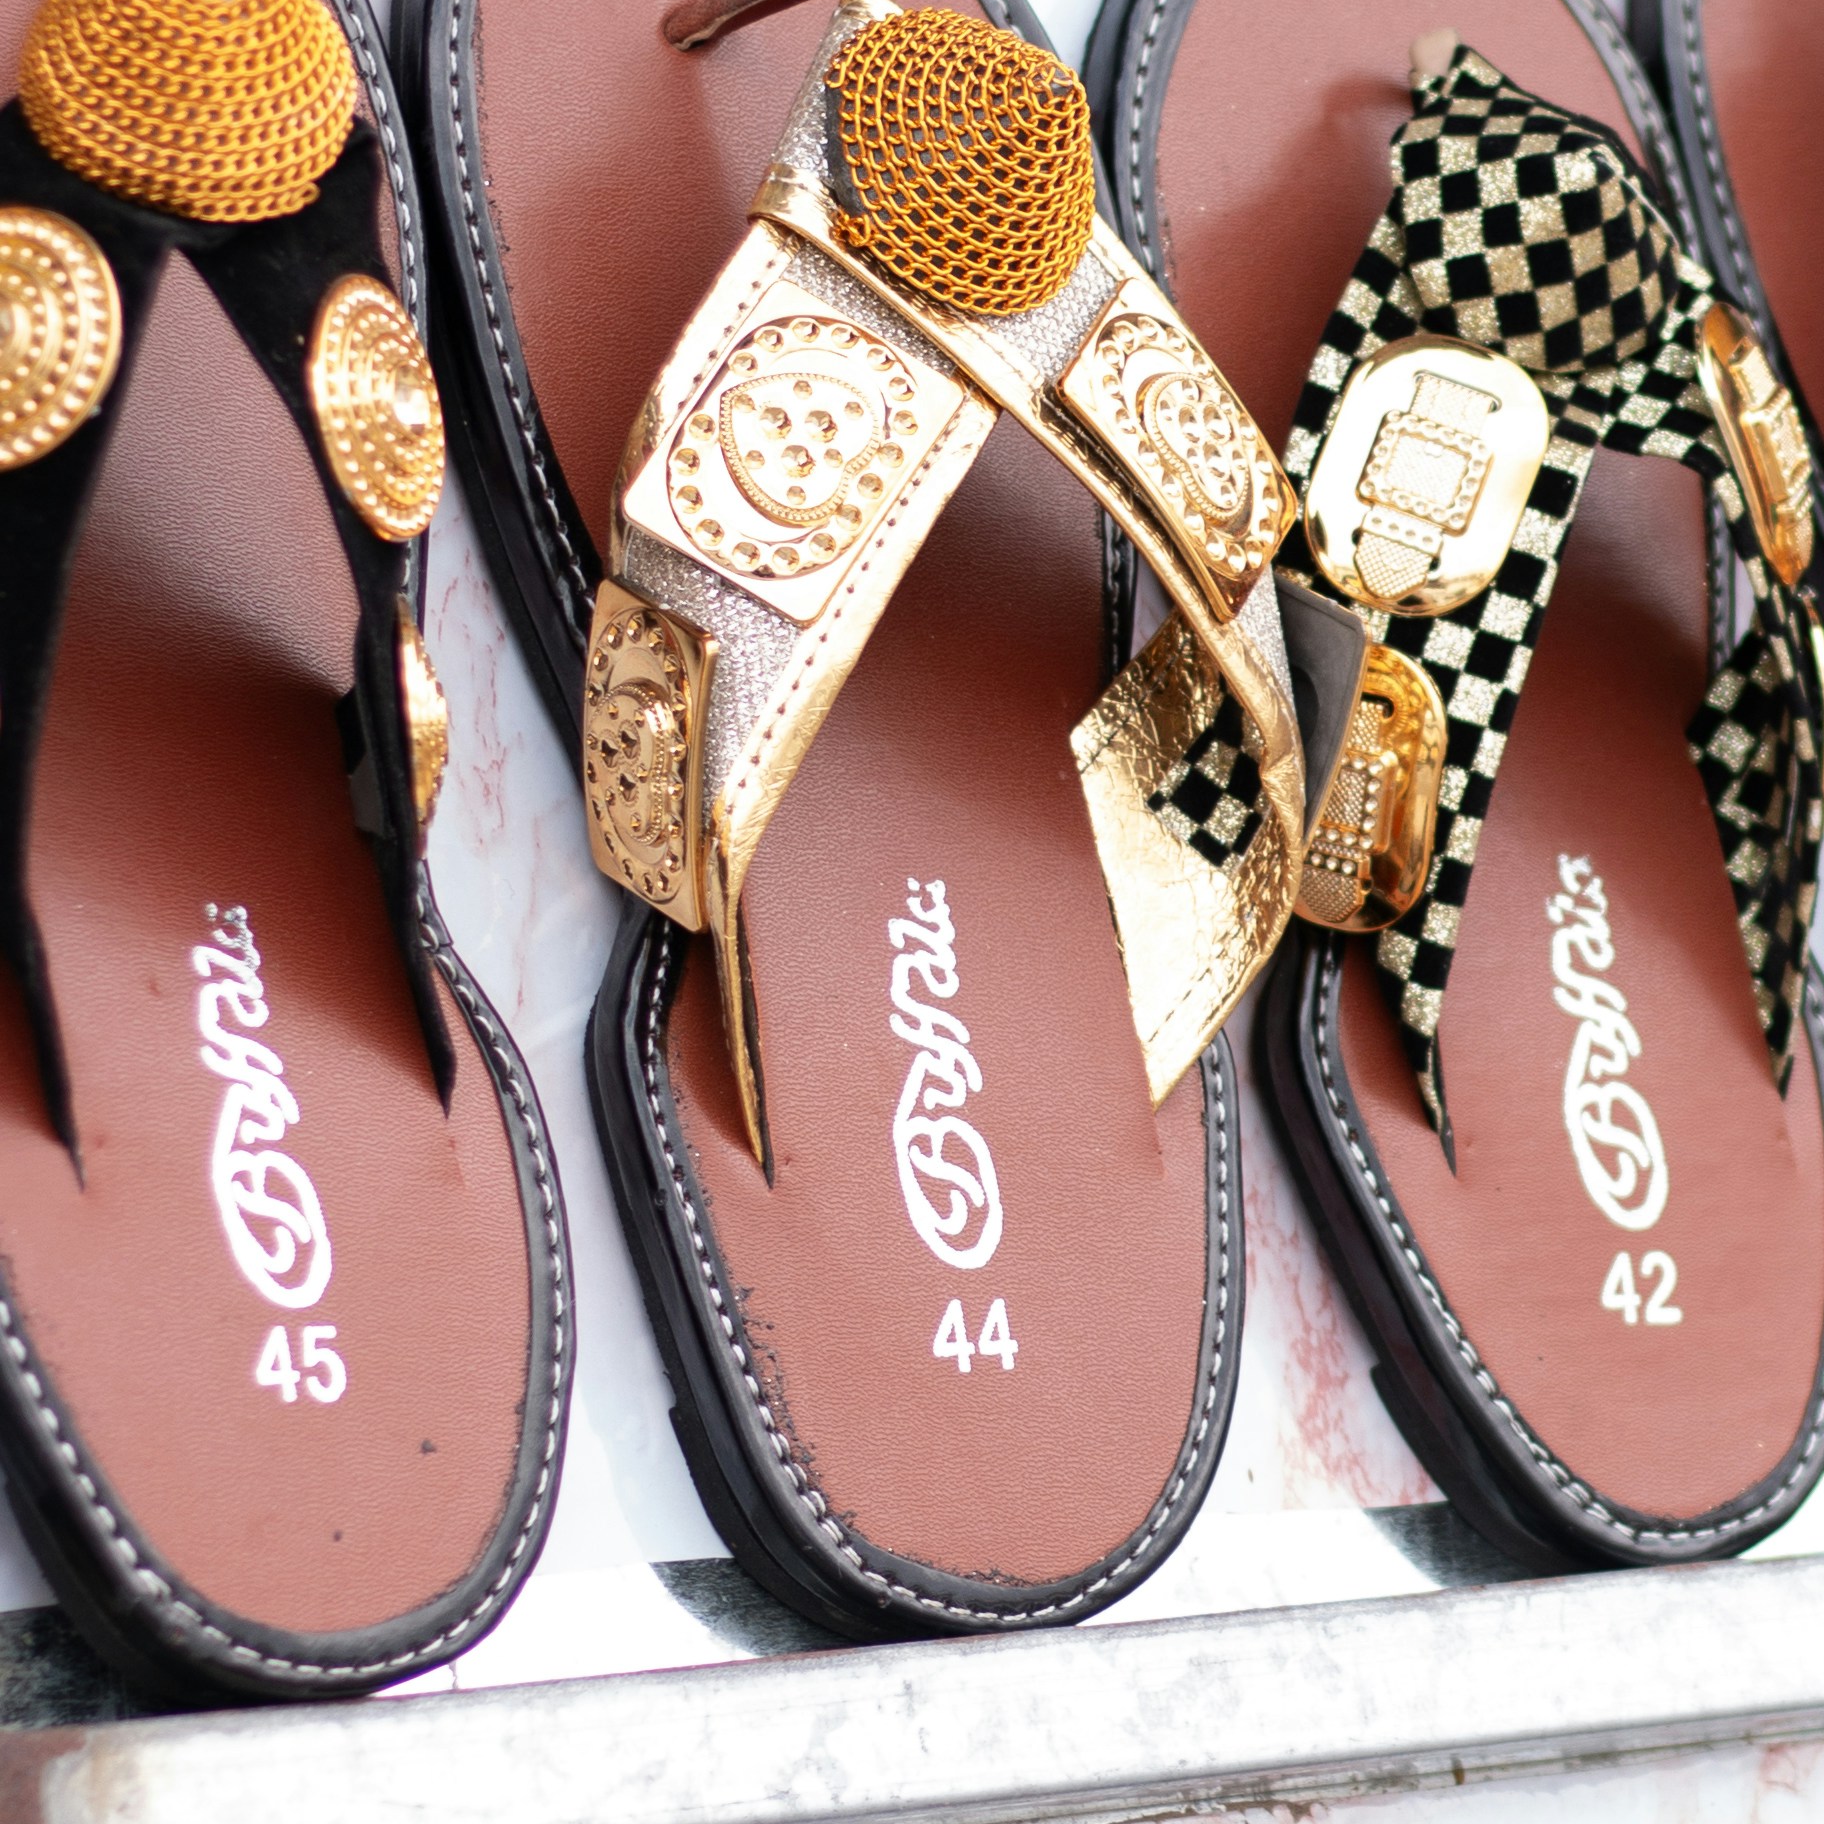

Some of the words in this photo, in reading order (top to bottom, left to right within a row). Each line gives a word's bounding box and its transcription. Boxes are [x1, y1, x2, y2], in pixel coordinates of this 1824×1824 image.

[1600, 1250, 1684, 1327] 42
[256, 1324, 348, 1404] 45
[932, 1297, 1019, 1373] 44
